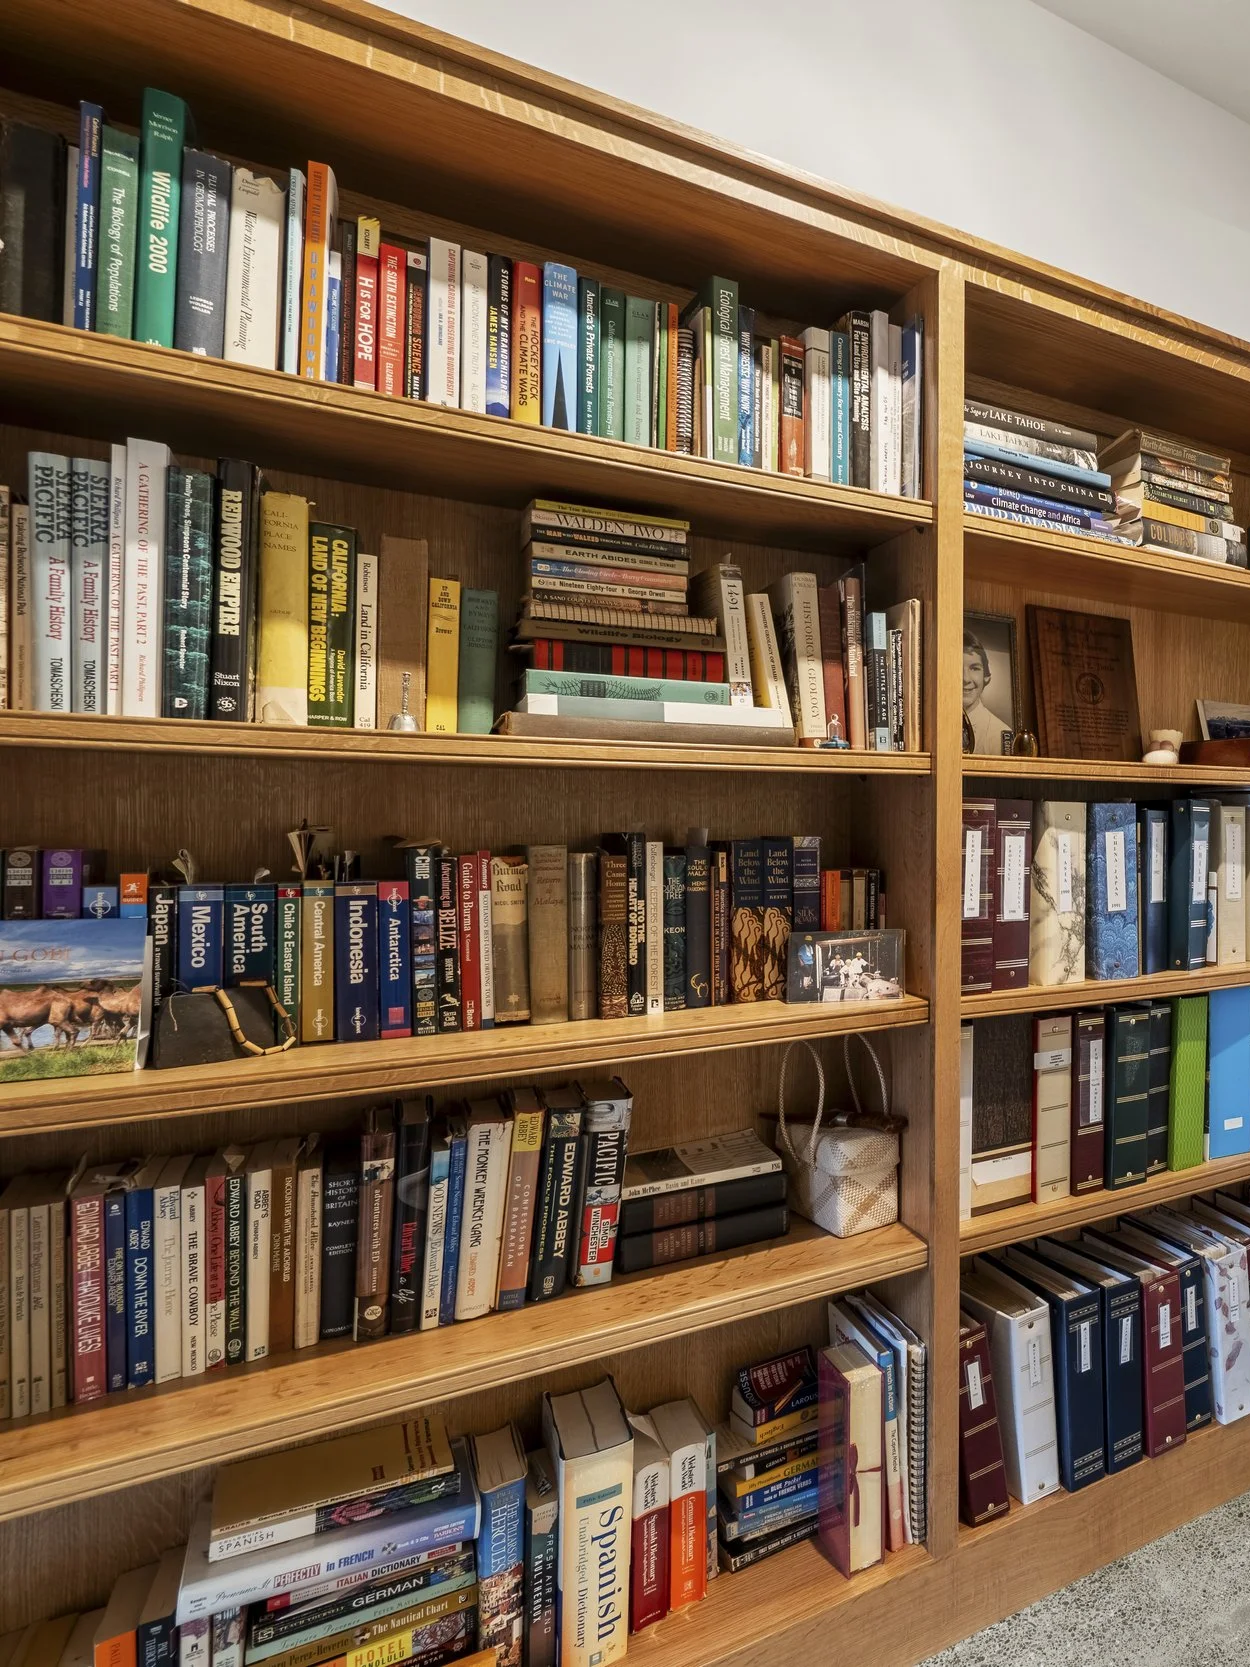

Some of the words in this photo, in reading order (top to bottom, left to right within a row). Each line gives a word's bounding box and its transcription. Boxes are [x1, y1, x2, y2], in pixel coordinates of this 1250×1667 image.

[196, 169, 205, 180] IN
[208, 174, 217, 208] FLUVIAL
[112, 187, 125, 205] The
[151, 171, 170, 231] Wildlife
[107, 206, 124, 241] Biology
[206, 211, 217, 253] PROCESSES
[245, 210, 257, 232] Water
[112, 243, 122, 256] of
[148, 235, 168, 274] 2000
[245, 234, 255, 242] in
[241, 243, 255, 305] Environmental
[388, 255, 399, 268] THE
[553, 272, 568, 281] THE
[108, 257, 122, 312] Populations
[359, 276, 374, 288] H
[360, 290, 371, 299] IS
[388, 269, 398, 291] SIXTH
[544, 280, 576, 294] CLIMATE
[552, 290, 569, 300] WAR
[359, 300, 371, 321] FOR
[386, 292, 397, 340] EXTINCTION
[489, 306, 497, 332] JAMES
[587, 290, 595, 329] America's
[720, 289, 733, 333] Ecological
[234, 306, 253, 351] Planning
[358, 322, 374, 361] HOPE
[530, 328, 540, 362] HOCKEY
[489, 334, 497, 369] HANSEN
[519, 333, 528, 372] CLIMATE
[586, 332, 595, 362] Private
[720, 336, 731, 361] Forest
[586, 365, 594, 393] Forests
[861, 332, 870, 397] ENVIRONMENTAL
[518, 374, 528, 406] WARS
[530, 364, 539, 401] STICK
[717, 363, 731, 421] Management
[861, 398, 870, 431] ANALYSIS
[970, 408, 981, 416] Saga
[982, 411, 988, 419] of
[990, 409, 1012, 423] LAKE
[1015, 416, 1046, 431] TAHOE
[969, 461, 1022, 479] JOURNEY
[1029, 476, 1055, 487] INTO
[1061, 483, 1094, 498] CHINA
[35, 466, 55, 544] PACIFIC
[55, 470, 72, 541] SIERRA
[137, 471, 149, 535] GATHERING
[991, 498, 1020, 511] Climate
[1020, 504, 1047, 518] Change
[1048, 511, 1061, 519] and
[1062, 513, 1081, 525] Africa
[220, 489, 242, 569] REDWOOD
[555, 513, 625, 535] WALDEN
[631, 522, 664, 540] TWO
[49, 556, 65, 566] A
[137, 540, 148, 554] OF
[312, 536, 328, 571] LAND
[565, 549, 599, 560] EARTH
[601, 553, 637, 564] ABIDES
[137, 558, 148, 575] THE
[312, 573, 327, 591] OF
[331, 540, 349, 617] CALIFORNIA:
[46, 567, 65, 602] Family
[136, 580, 148, 610] PAST,
[559, 581, 585, 590] Nineteen
[586, 584, 617, 593] Eighty-four
[628, 587, 647, 596] George
[649, 589, 665, 598] Orwell
[218, 572, 241, 636] EMPIRE
[311, 593, 326, 624] NEW
[361, 604, 372, 629] Land
[45, 604, 65, 641] History
[136, 612, 147, 637] PART
[360, 631, 369, 640] in
[803, 601, 815, 665] HISTORICAL
[214, 672, 240, 680] Stuart
[308, 626, 326, 702] BEGINNINGS
[338, 650, 346, 671] David
[360, 643, 371, 691] California
[50, 658, 63, 710] TOMASCHESKI
[336, 673, 345, 704] Lavender
[806, 667, 820, 718] GEOLOGY
[767, 858, 789, 866] Below
[768, 849, 788, 857] Land
[768, 876, 789, 884] Wind
[772, 868, 784, 876] the
[629, 878, 637, 912] HEART
[151, 893, 173, 945] Japan
[251, 903, 269, 953] South
[283, 903, 295, 927] Chile
[313, 901, 325, 938] Central
[439, 908, 456, 950] BELIZE
[629, 913, 637, 926] OF
[191, 905, 211, 969] Mexico
[232, 903, 250, 974] America
[284, 929, 295, 939] &
[350, 900, 369, 984] Indonesia
[388, 918, 403, 981] Antarctica
[629, 927, 637, 965] BORNEO
[283, 940, 295, 973] Easter
[313, 942, 325, 986] America
[283, 974, 295, 1006] Island
[478, 1129, 491, 1146] THE
[476, 1148, 490, 1184] MONKEY
[559, 1142, 576, 1206] EDWARD
[595, 1132, 620, 1186] PACIFIC
[229, 1178, 240, 1217] EDWARD
[472, 1185, 486, 1219] WRENCH
[229, 1219, 240, 1248] ABBEY
[469, 1220, 483, 1248] GANG
[553, 1208, 570, 1258] ABBEY
[587, 1208, 601, 1263] WINCHESTER
[599, 1219, 610, 1248] SIMON
[134, 1257, 148, 1289] DOWN
[229, 1250, 240, 1286] BEYOND
[134, 1290, 147, 1306] THE
[229, 1287, 240, 1305] THE
[134, 1307, 148, 1337] RIVER
[229, 1307, 240, 1332] WALL
[218, 1531, 274, 1553] SPANISH
[578, 1516, 589, 1585] Unabridged
[274, 1563, 321, 1588] PERFECTLY
[326, 1561, 335, 1572] in
[338, 1550, 374, 1569] FRENCH
[336, 1572, 369, 1589] ITALIAN
[371, 1555, 421, 1577] DICTIONARY
[591, 1505, 624, 1642] Spanish
[352, 1577, 423, 1608] GERMAN
[373, 1624, 388, 1635] The
[390, 1610, 424, 1631] Nautical
[426, 1602, 448, 1619] Chart
[576, 1587, 588, 1649] Dictionary
